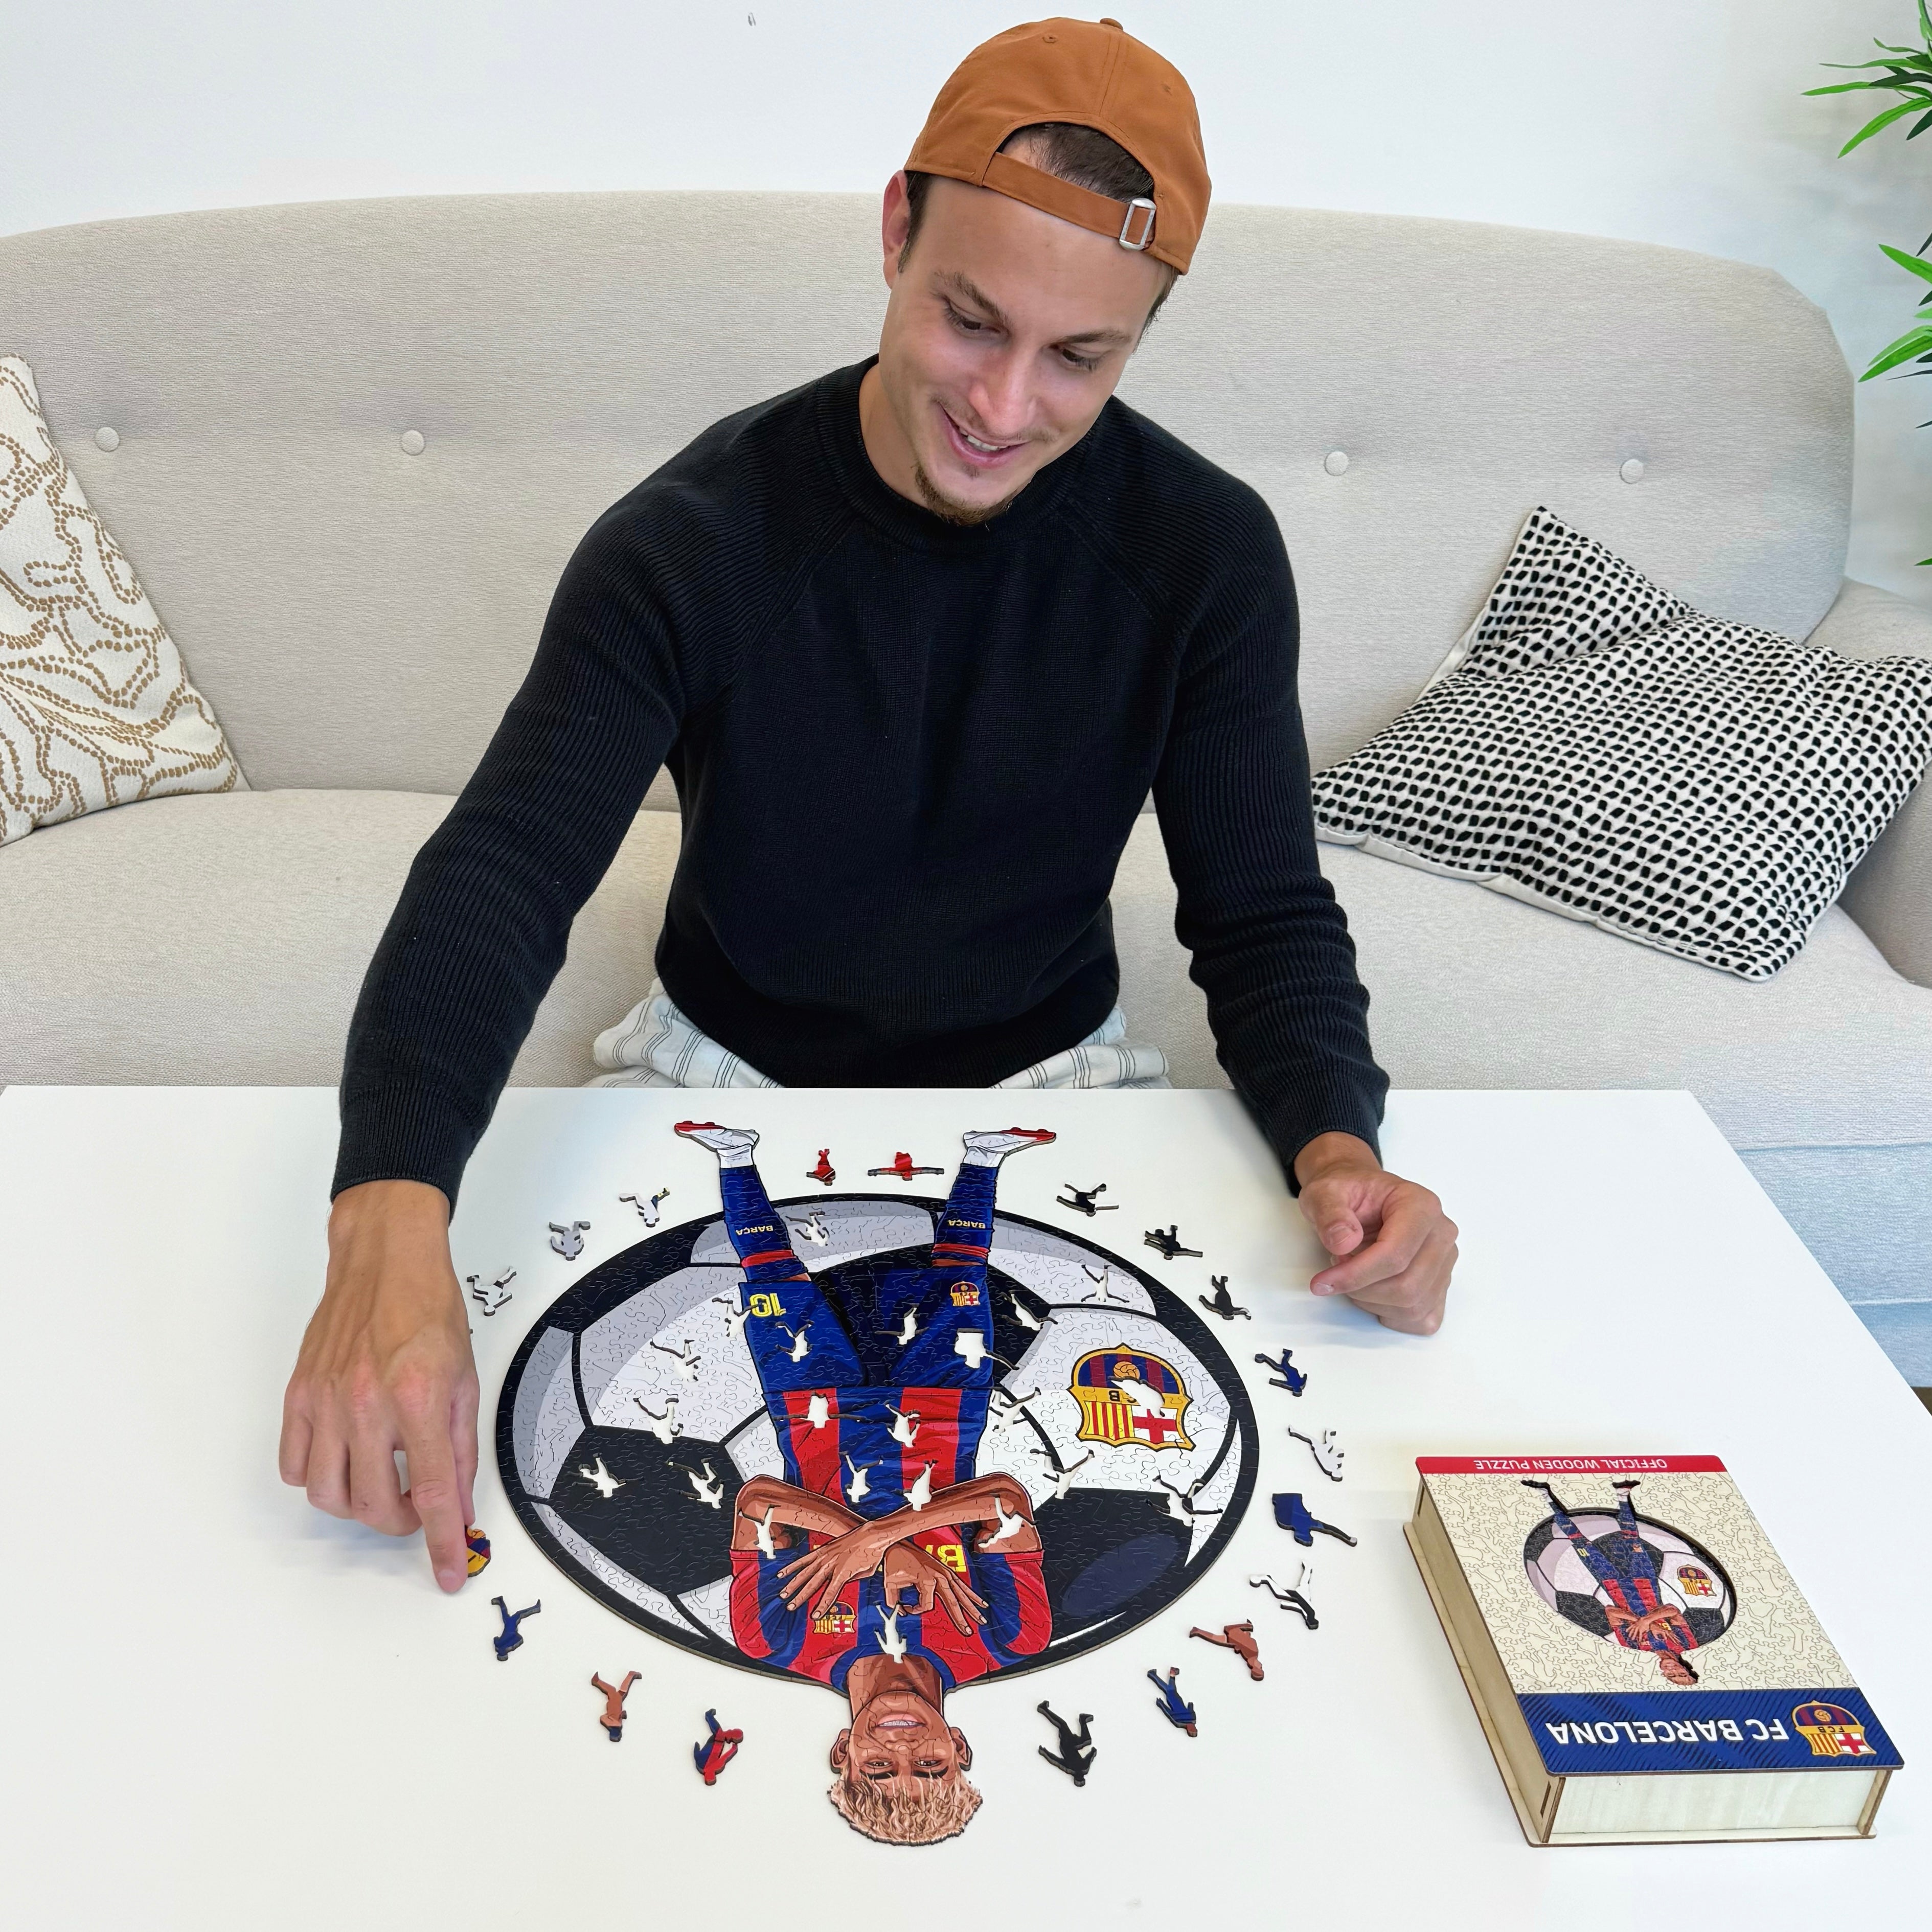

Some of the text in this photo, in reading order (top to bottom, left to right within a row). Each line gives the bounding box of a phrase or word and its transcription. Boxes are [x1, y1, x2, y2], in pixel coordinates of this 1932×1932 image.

[948, 1219, 986, 1229] BARÇA
[735, 1225, 774, 1236] BARÇA
[749, 1293, 787, 1317] 10
[1473, 1459, 1668, 1470] OFFICIAL WOODEN PUZZLE
[1545, 1718, 1790, 1745] FC BARCELONA
